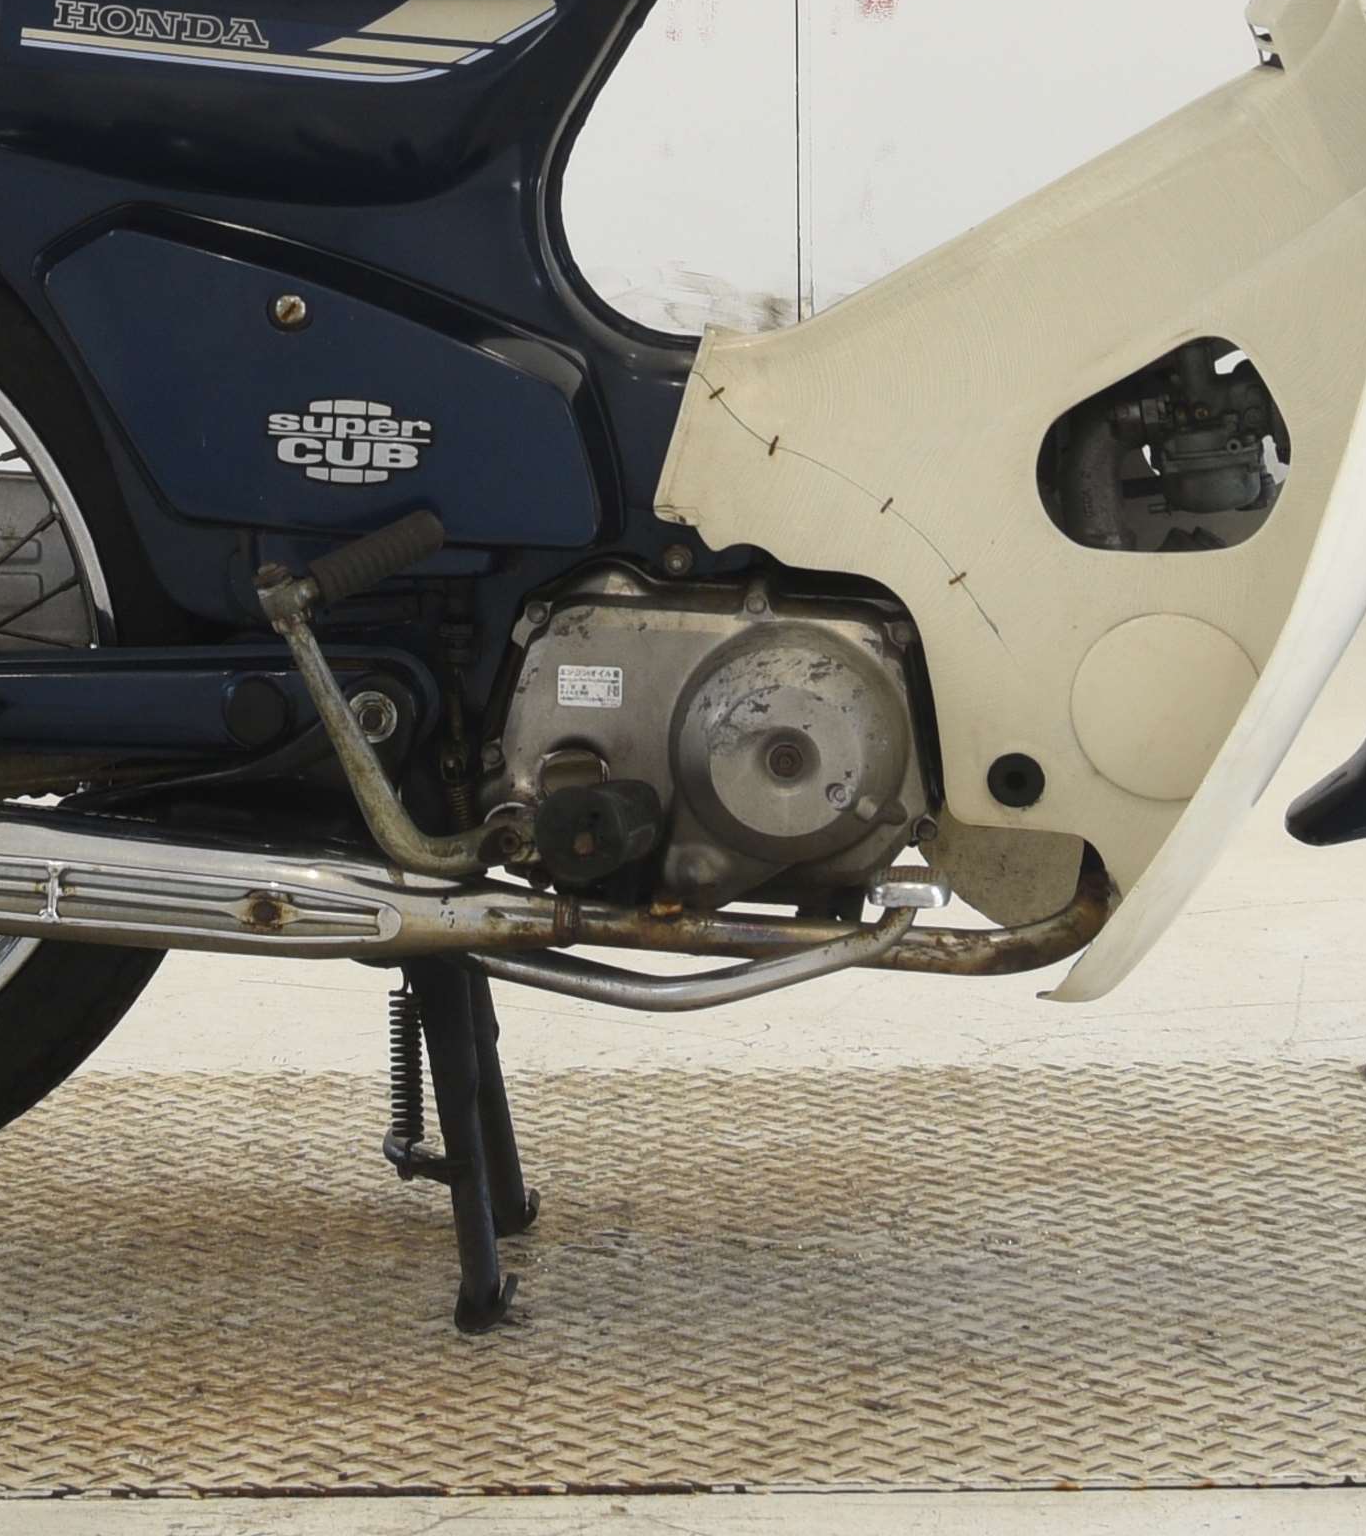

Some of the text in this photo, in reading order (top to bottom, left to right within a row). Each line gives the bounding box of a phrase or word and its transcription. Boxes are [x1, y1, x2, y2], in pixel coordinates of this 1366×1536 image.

[53, 0, 269, 49] HONDA
[268, 413, 431, 439] super
[277, 437, 418, 469] CUB
